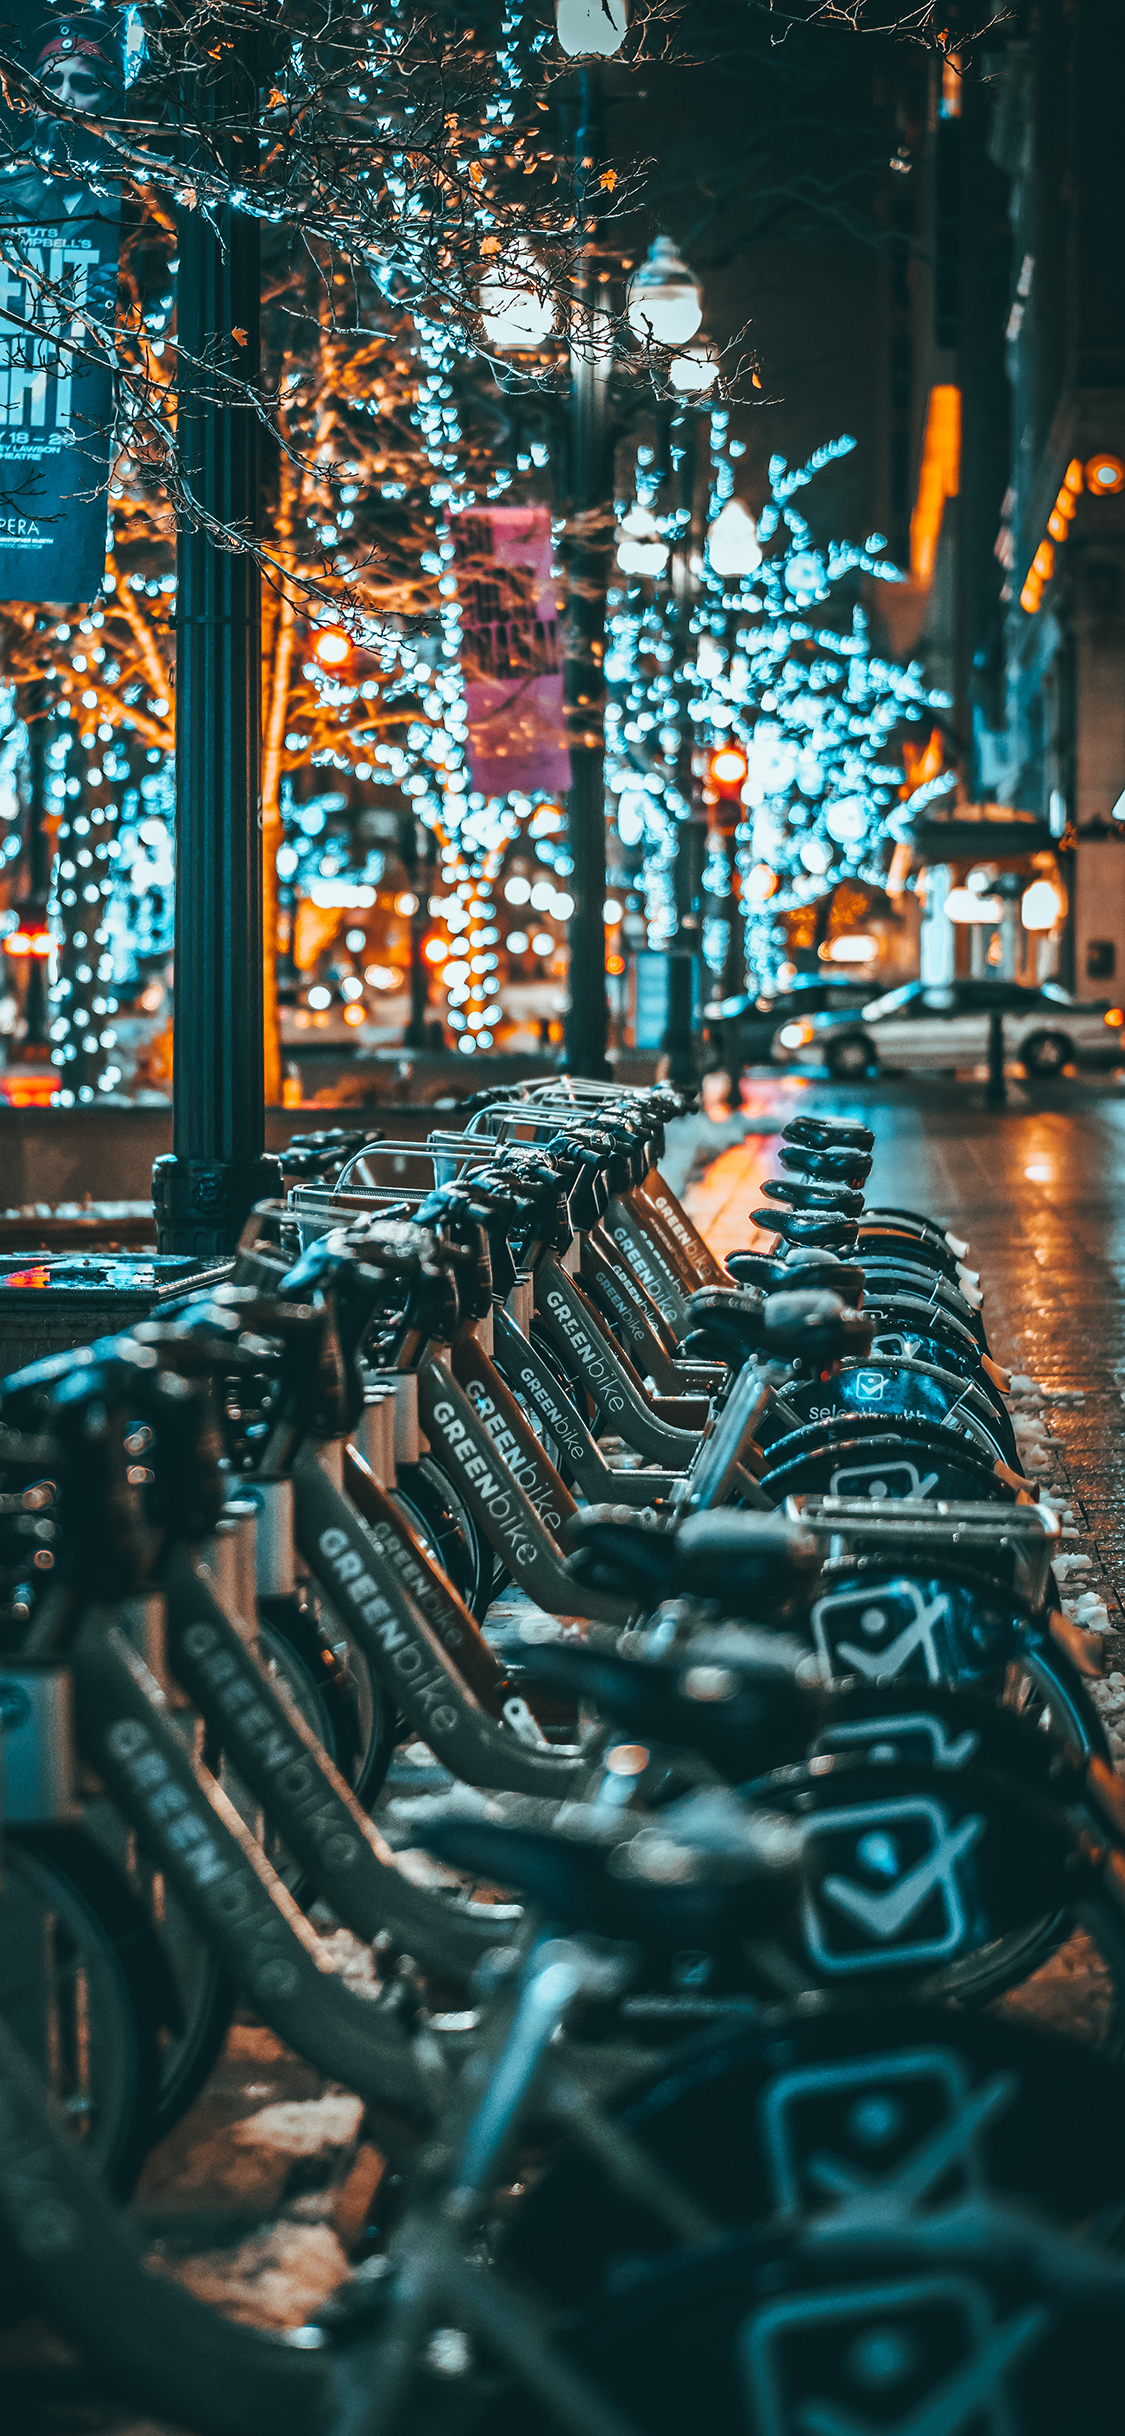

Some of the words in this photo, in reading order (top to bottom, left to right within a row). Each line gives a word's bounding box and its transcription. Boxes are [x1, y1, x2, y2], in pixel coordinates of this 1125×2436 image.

[9, 431, 30, 444] 18
[13, 445, 61, 454] LAWSON
[613, 1227, 678, 1323] GREENbike
[655, 1196, 712, 1278] GREENbike
[547, 1291, 625, 1413] GREENbike
[595, 1272, 645, 1341] GREENbike
[466, 1379, 561, 1530] GREENbike
[520, 1367, 584, 1460] GREENbike
[433, 1401, 538, 1566] GREENbike
[319, 1527, 459, 1733] GREENbike
